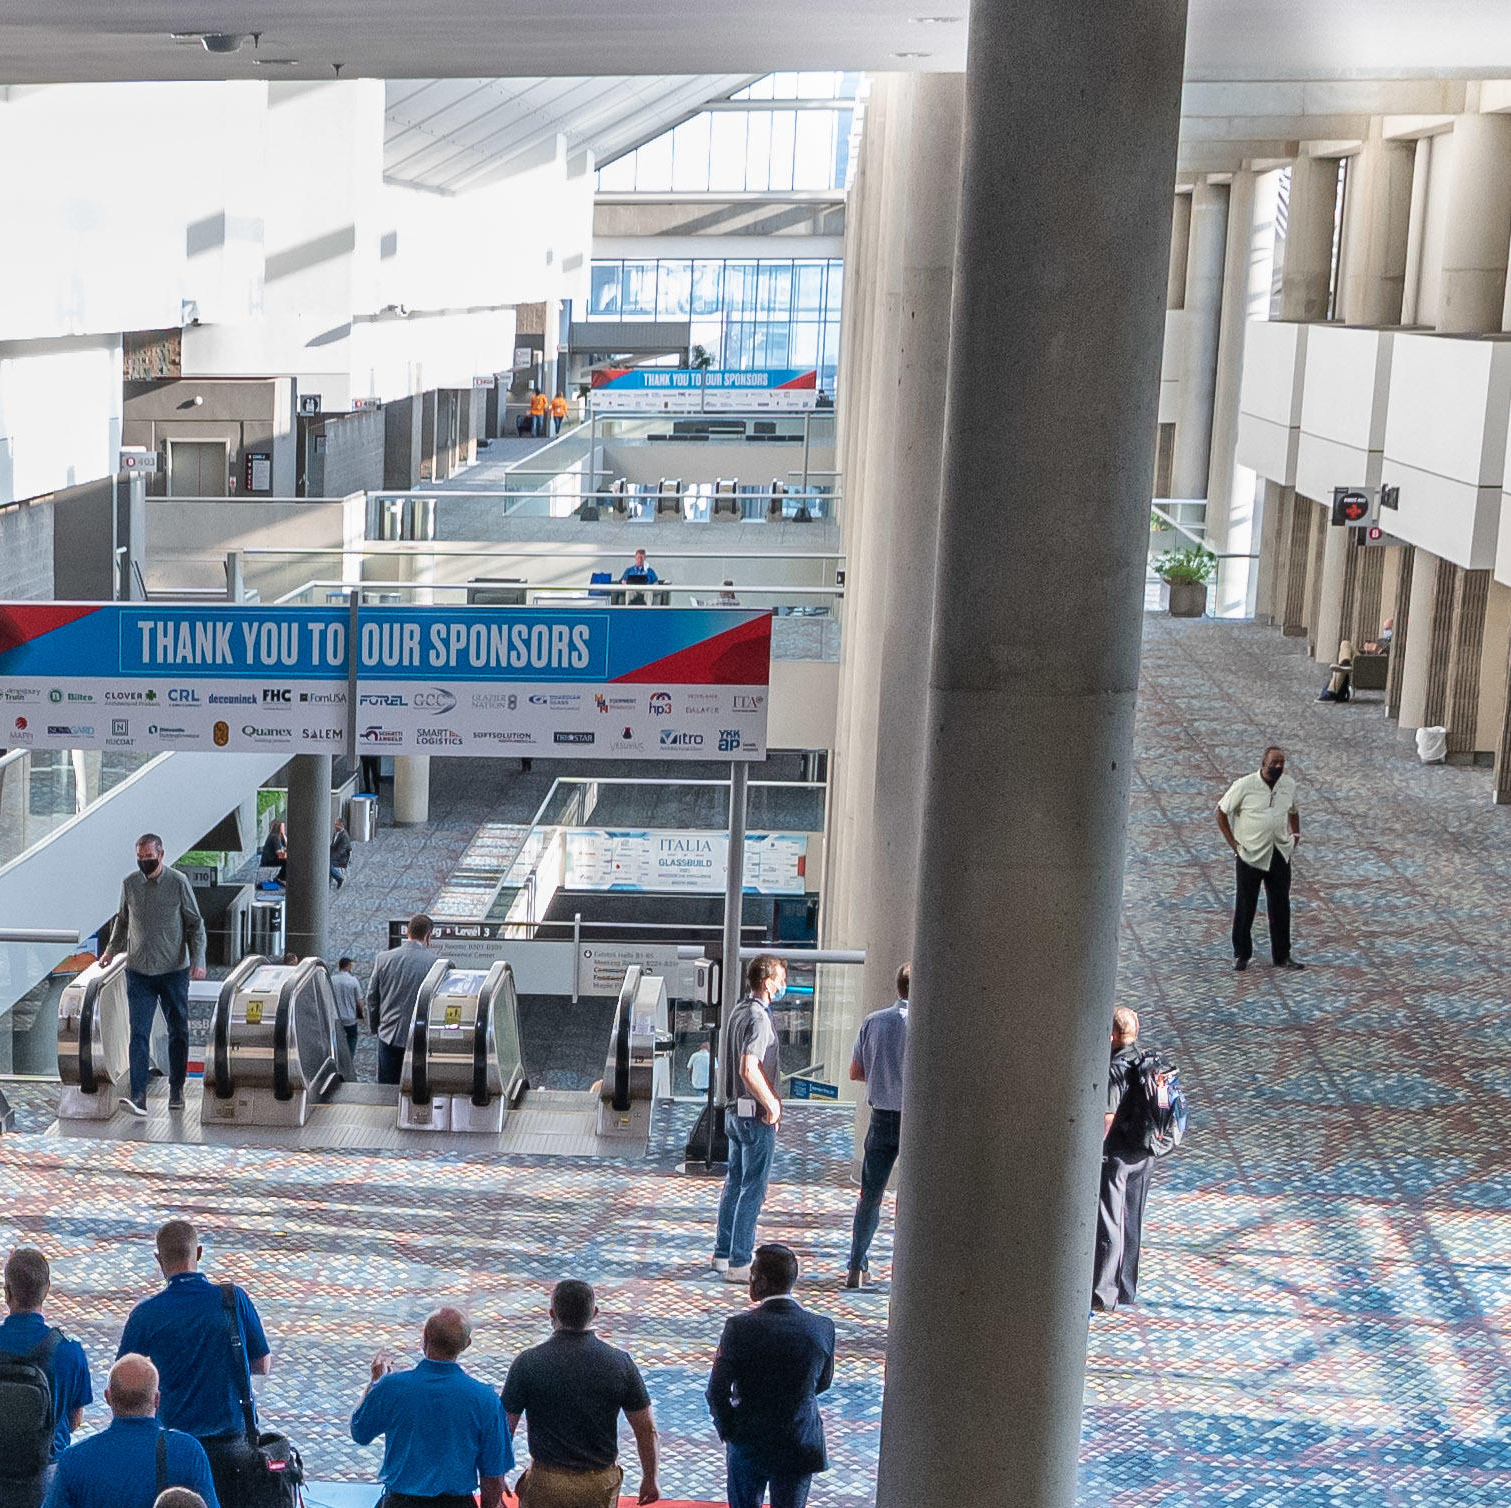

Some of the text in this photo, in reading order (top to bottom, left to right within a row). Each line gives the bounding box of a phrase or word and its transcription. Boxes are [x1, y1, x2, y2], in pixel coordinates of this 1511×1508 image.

[644, 373, 768, 386] THANK YOU TO OUR SPONSORS
[137, 621, 590, 668] THANK YOU TO OUR SPONSORS
[168, 689, 200, 702] CRL
[262, 689, 292, 702] FHC
[241, 724, 292, 737] Quanex
[302, 728, 343, 739] SALEM
[416, 728, 449, 738] SMART
[660, 729, 704, 745] Vitro
[718, 730, 740, 738] YKK
[416, 737, 463, 745] LOGISTICS
[660, 839, 712, 852] ITALIA
[658, 858, 713, 868] GLASSBUILD
[455, 926, 481, 937] Level
[483, 927, 490, 938] 3
